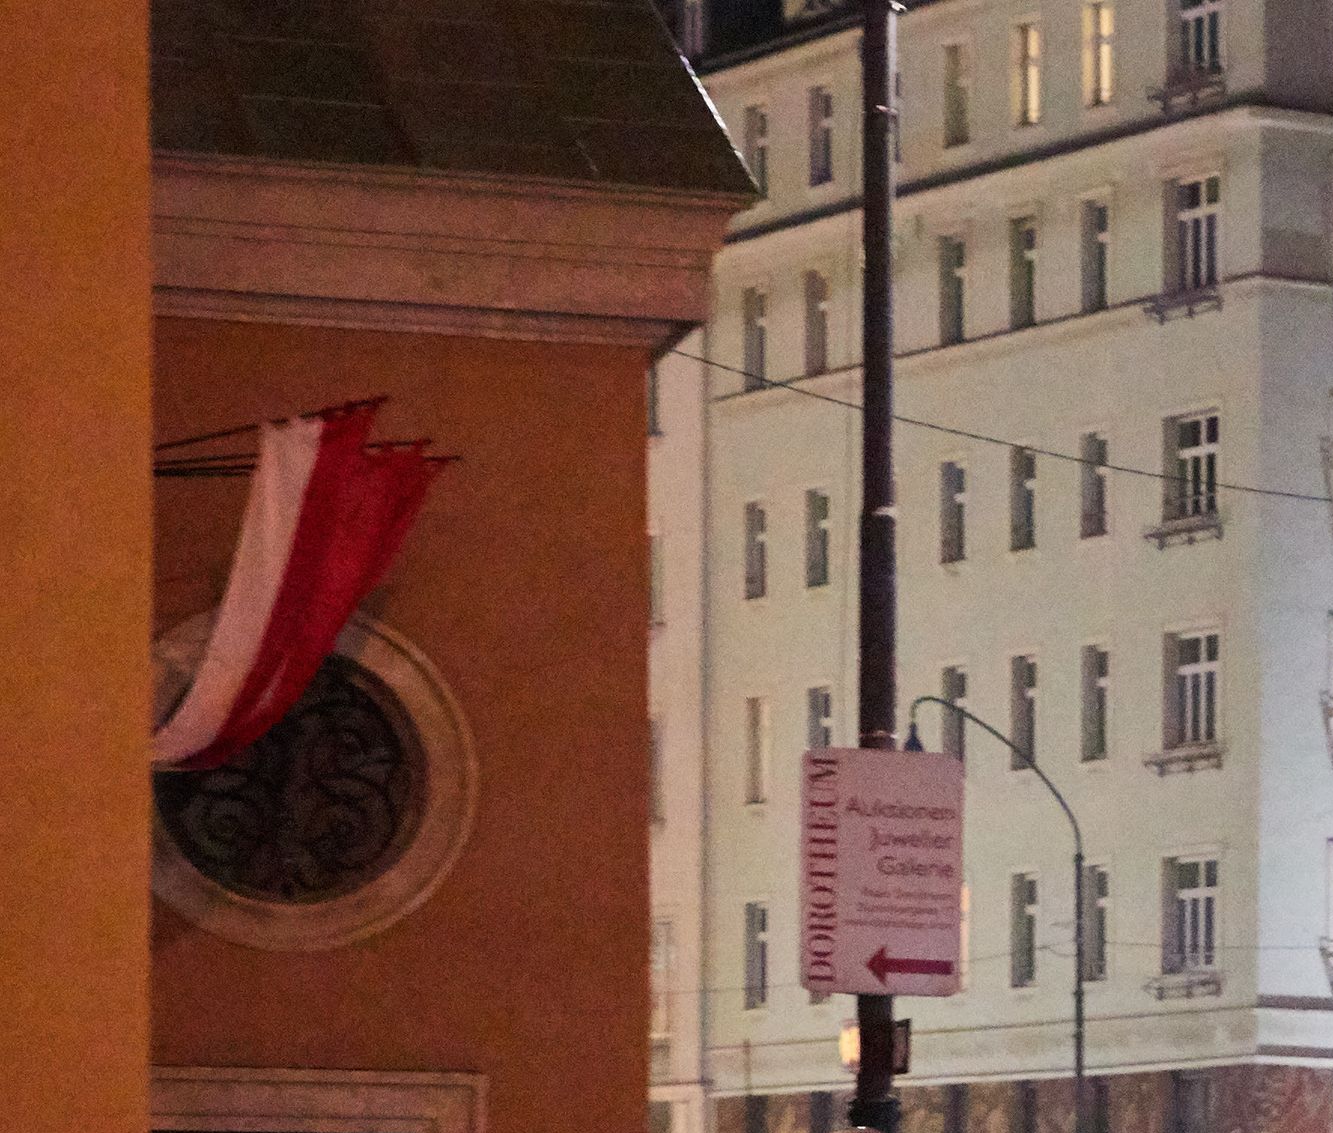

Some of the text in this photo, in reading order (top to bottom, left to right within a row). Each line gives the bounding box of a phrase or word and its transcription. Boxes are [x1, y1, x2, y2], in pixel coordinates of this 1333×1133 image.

[846, 797, 955, 820] Auktionen
[869, 826, 953, 851] Juwelier
[808, 757, 838, 982] DOROTHEUM
[877, 855, 954, 879] Galerie
